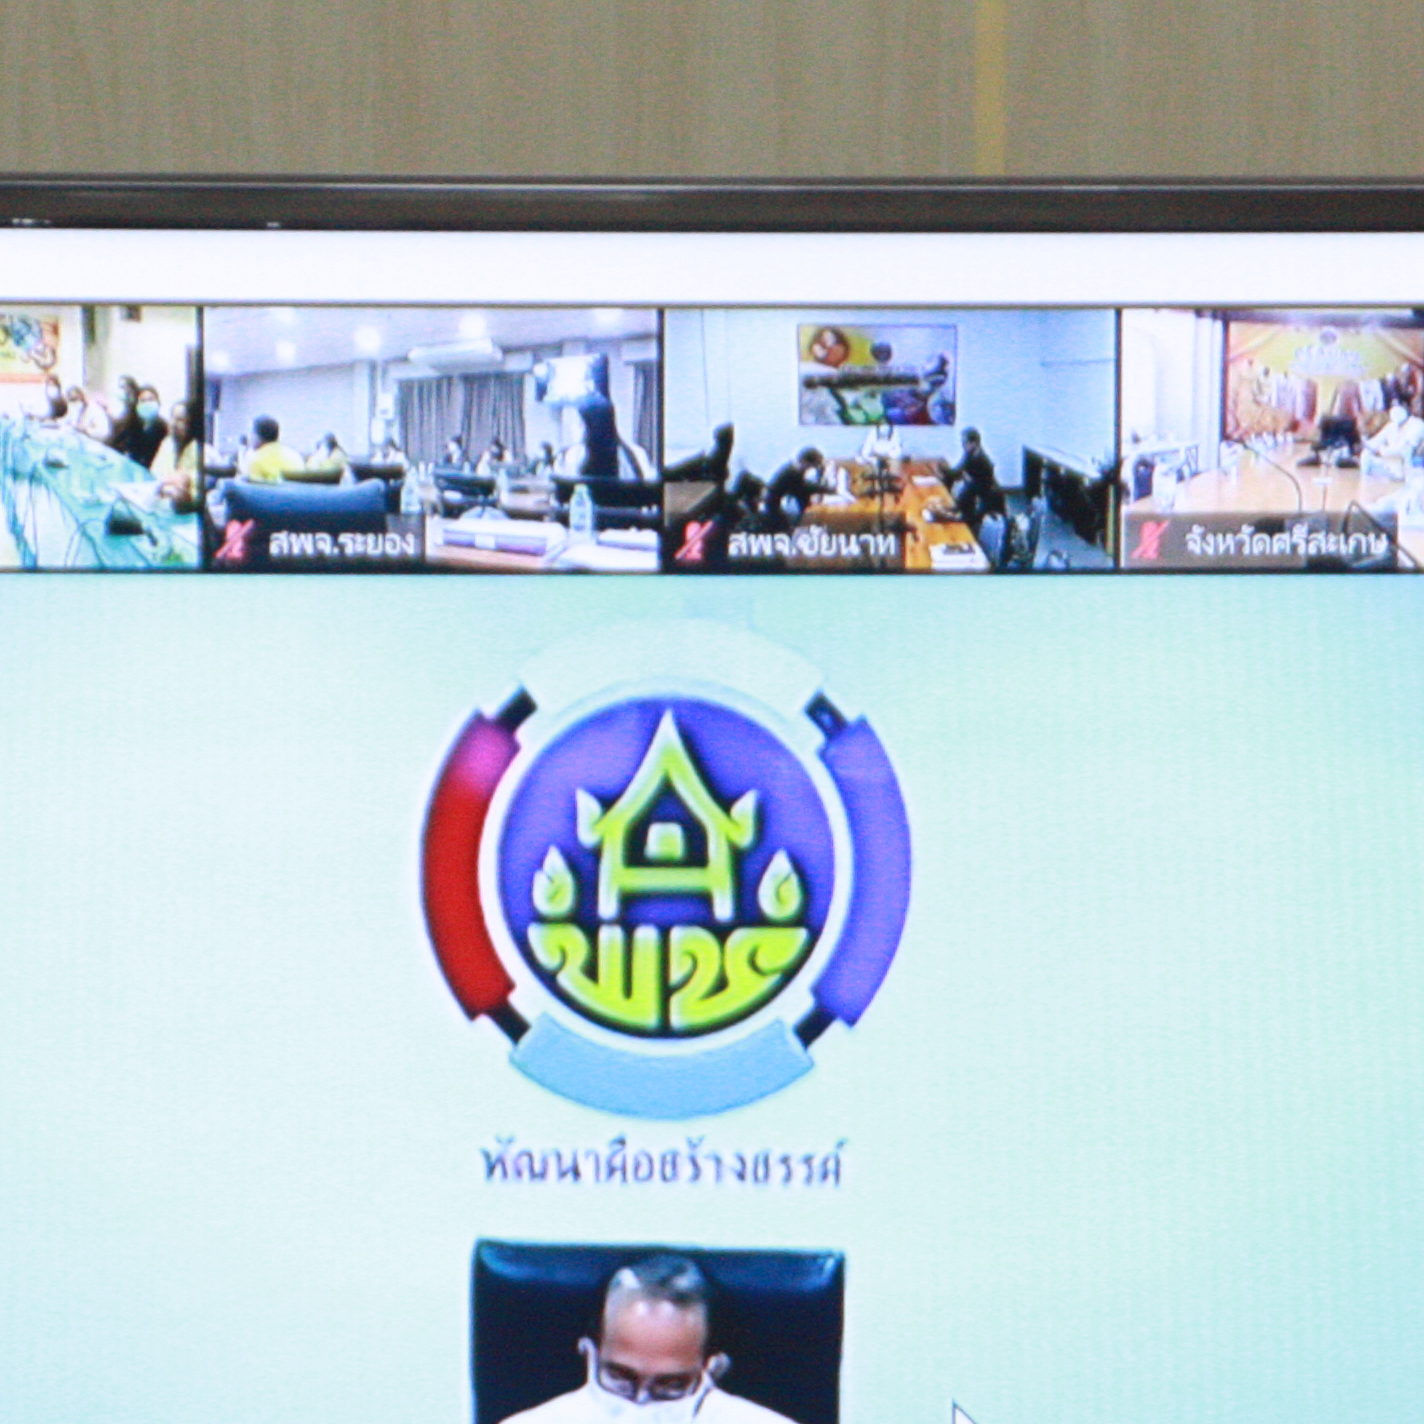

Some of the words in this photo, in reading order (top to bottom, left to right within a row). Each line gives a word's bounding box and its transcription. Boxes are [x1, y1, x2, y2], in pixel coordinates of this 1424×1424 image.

[269, 527, 416, 558] สพจ.ระยอง
[728, 524, 896, 557] สพจ.ชัยนาท
